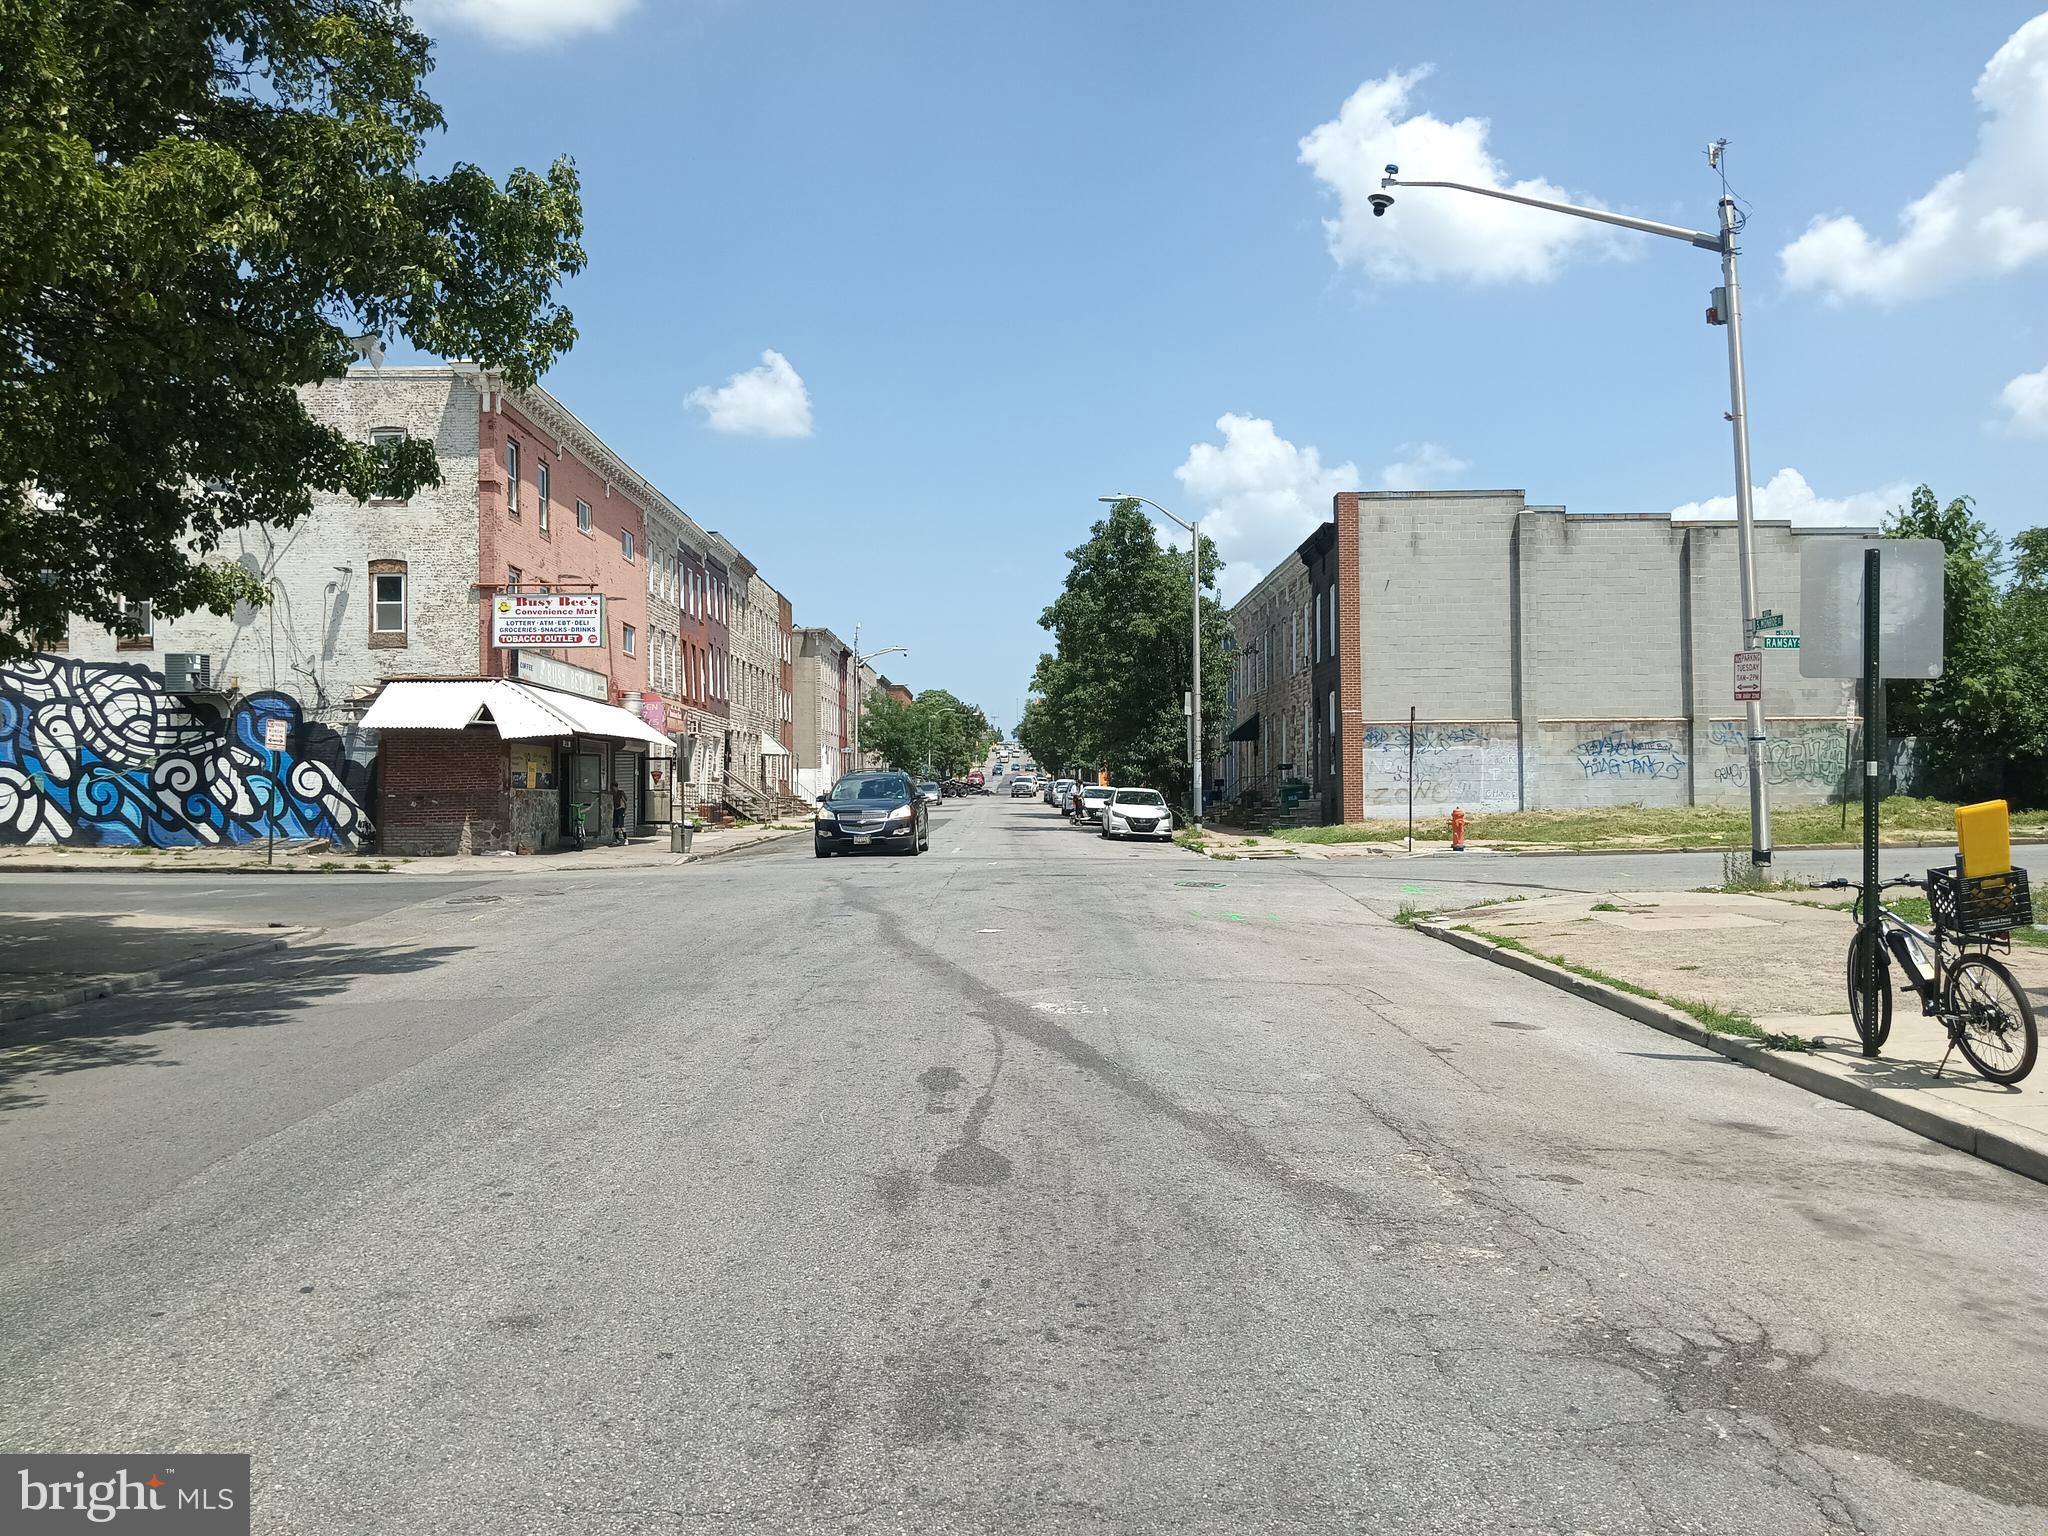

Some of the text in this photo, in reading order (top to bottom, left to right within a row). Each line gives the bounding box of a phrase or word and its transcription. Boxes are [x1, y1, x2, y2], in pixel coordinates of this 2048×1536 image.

[516, 596, 598, 609] Busy Bee's
[500, 635, 542, 643] TOBACCO
[1766, 638, 1797, 648] RAMSAY
[1736, 664, 1760, 672] TUESDAY
